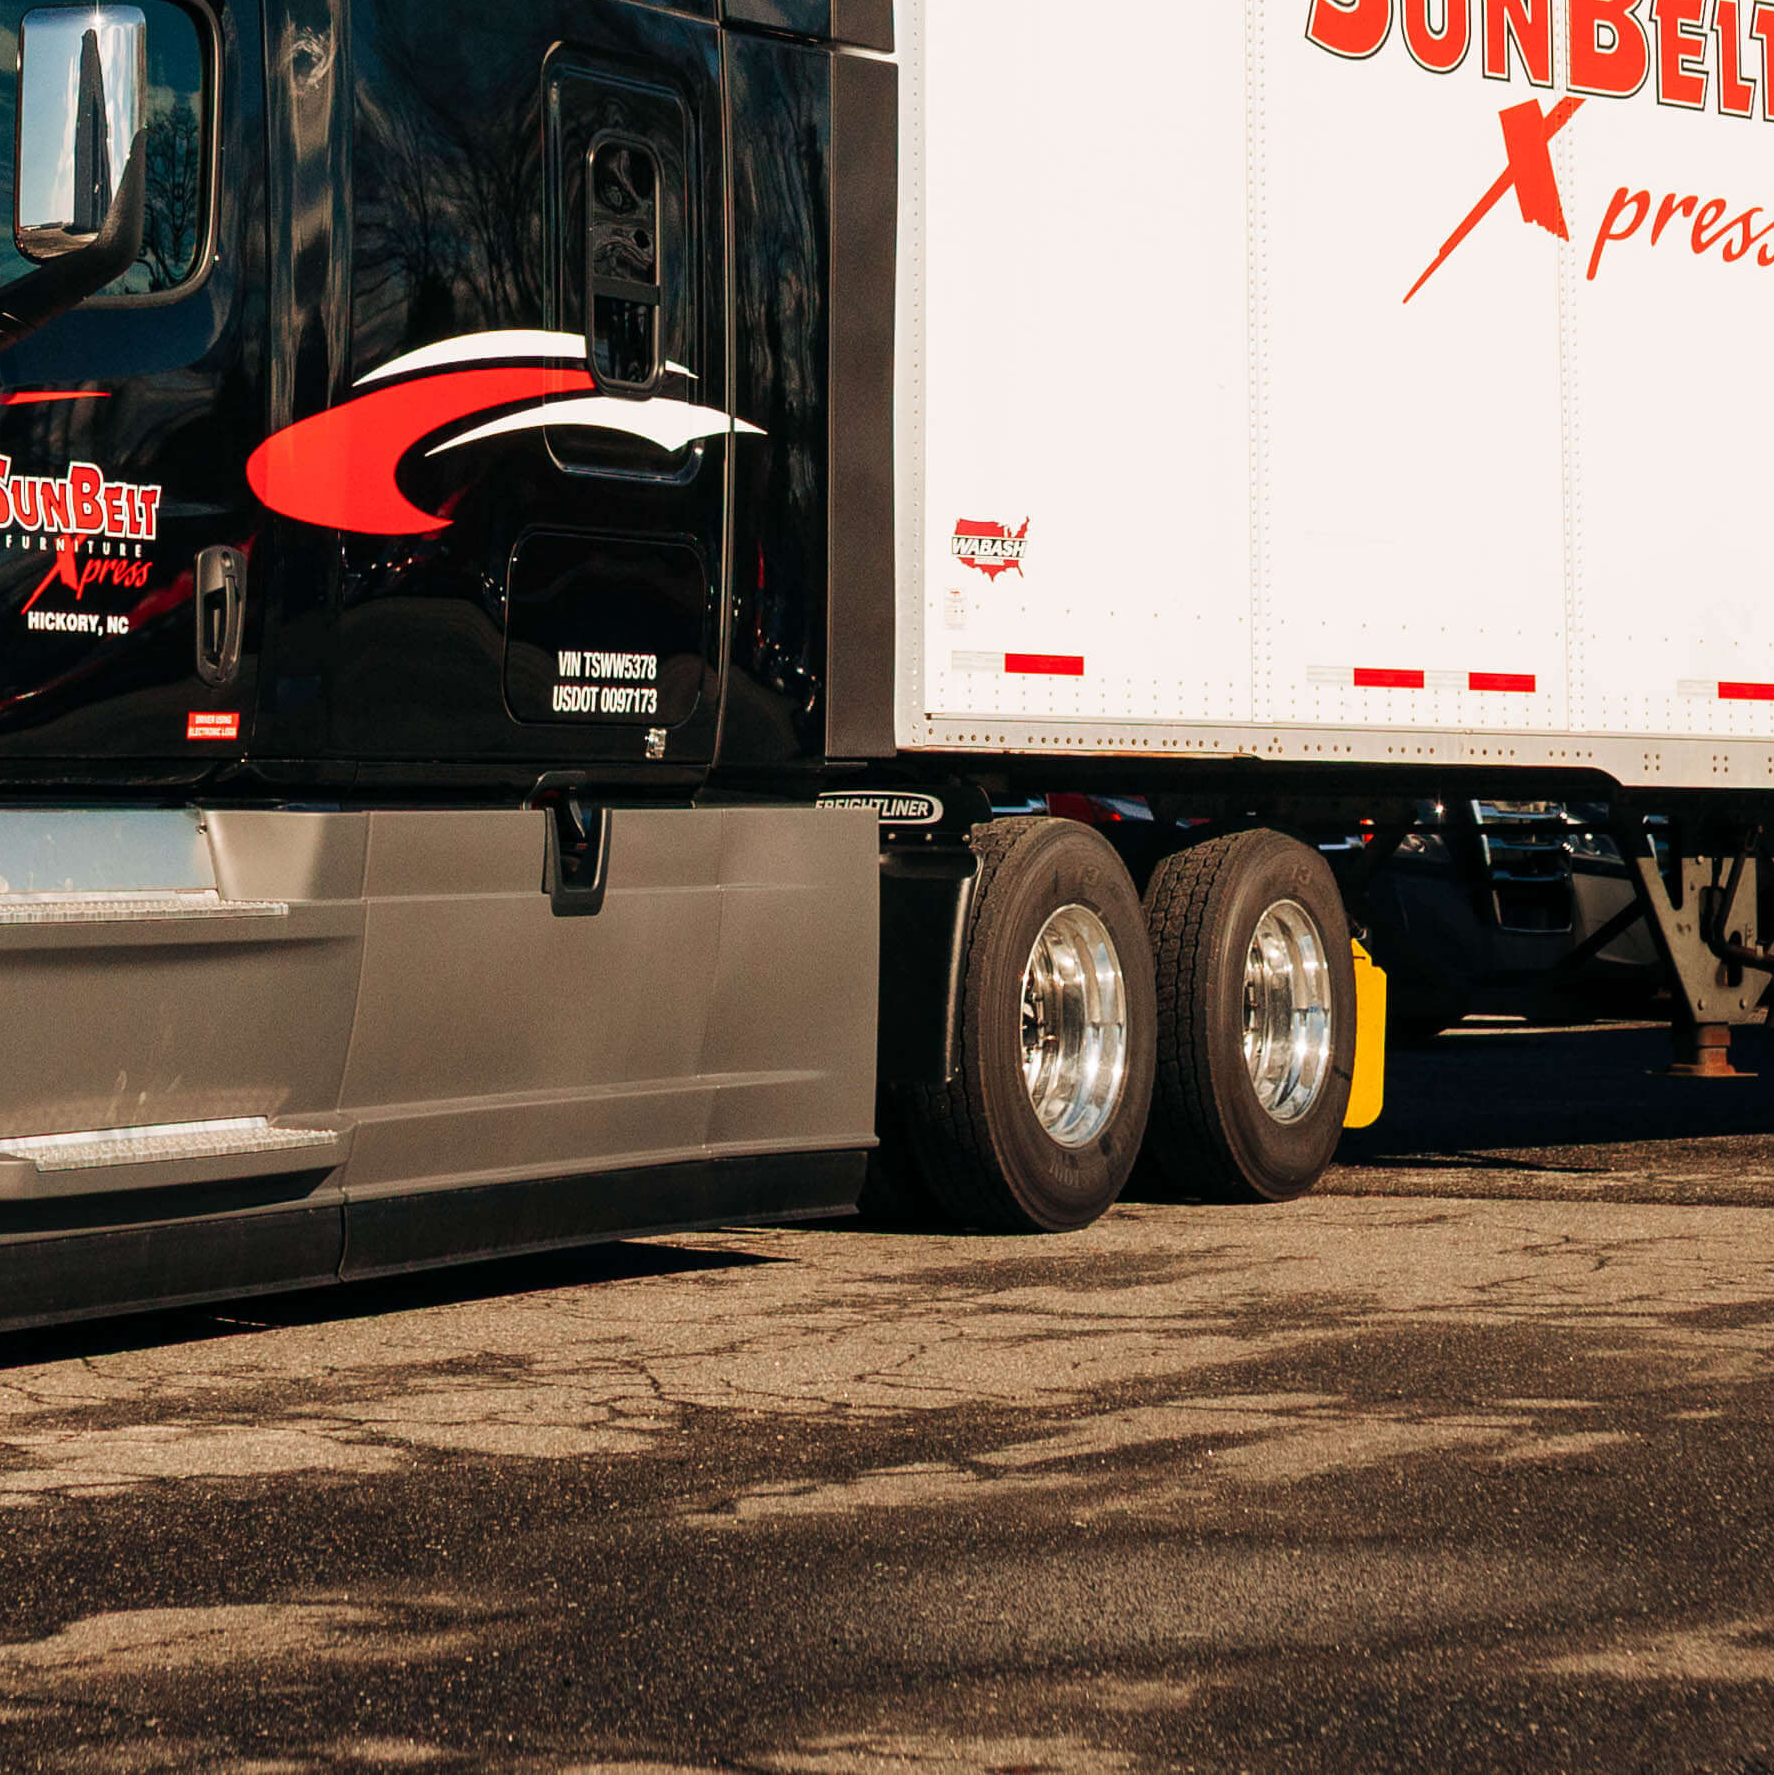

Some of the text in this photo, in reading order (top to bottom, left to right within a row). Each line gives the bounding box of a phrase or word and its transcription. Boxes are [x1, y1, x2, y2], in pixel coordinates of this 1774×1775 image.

[5, 534, 143, 559] FURNITURE
[952, 536, 1027, 558] WABASH
[20, 532, 153, 615] Xpress
[27, 610, 129, 637] HICKORY, NC
[557, 650, 657, 680] VIN TSWW5378
[552, 684, 658, 714] USDOT 0097173
